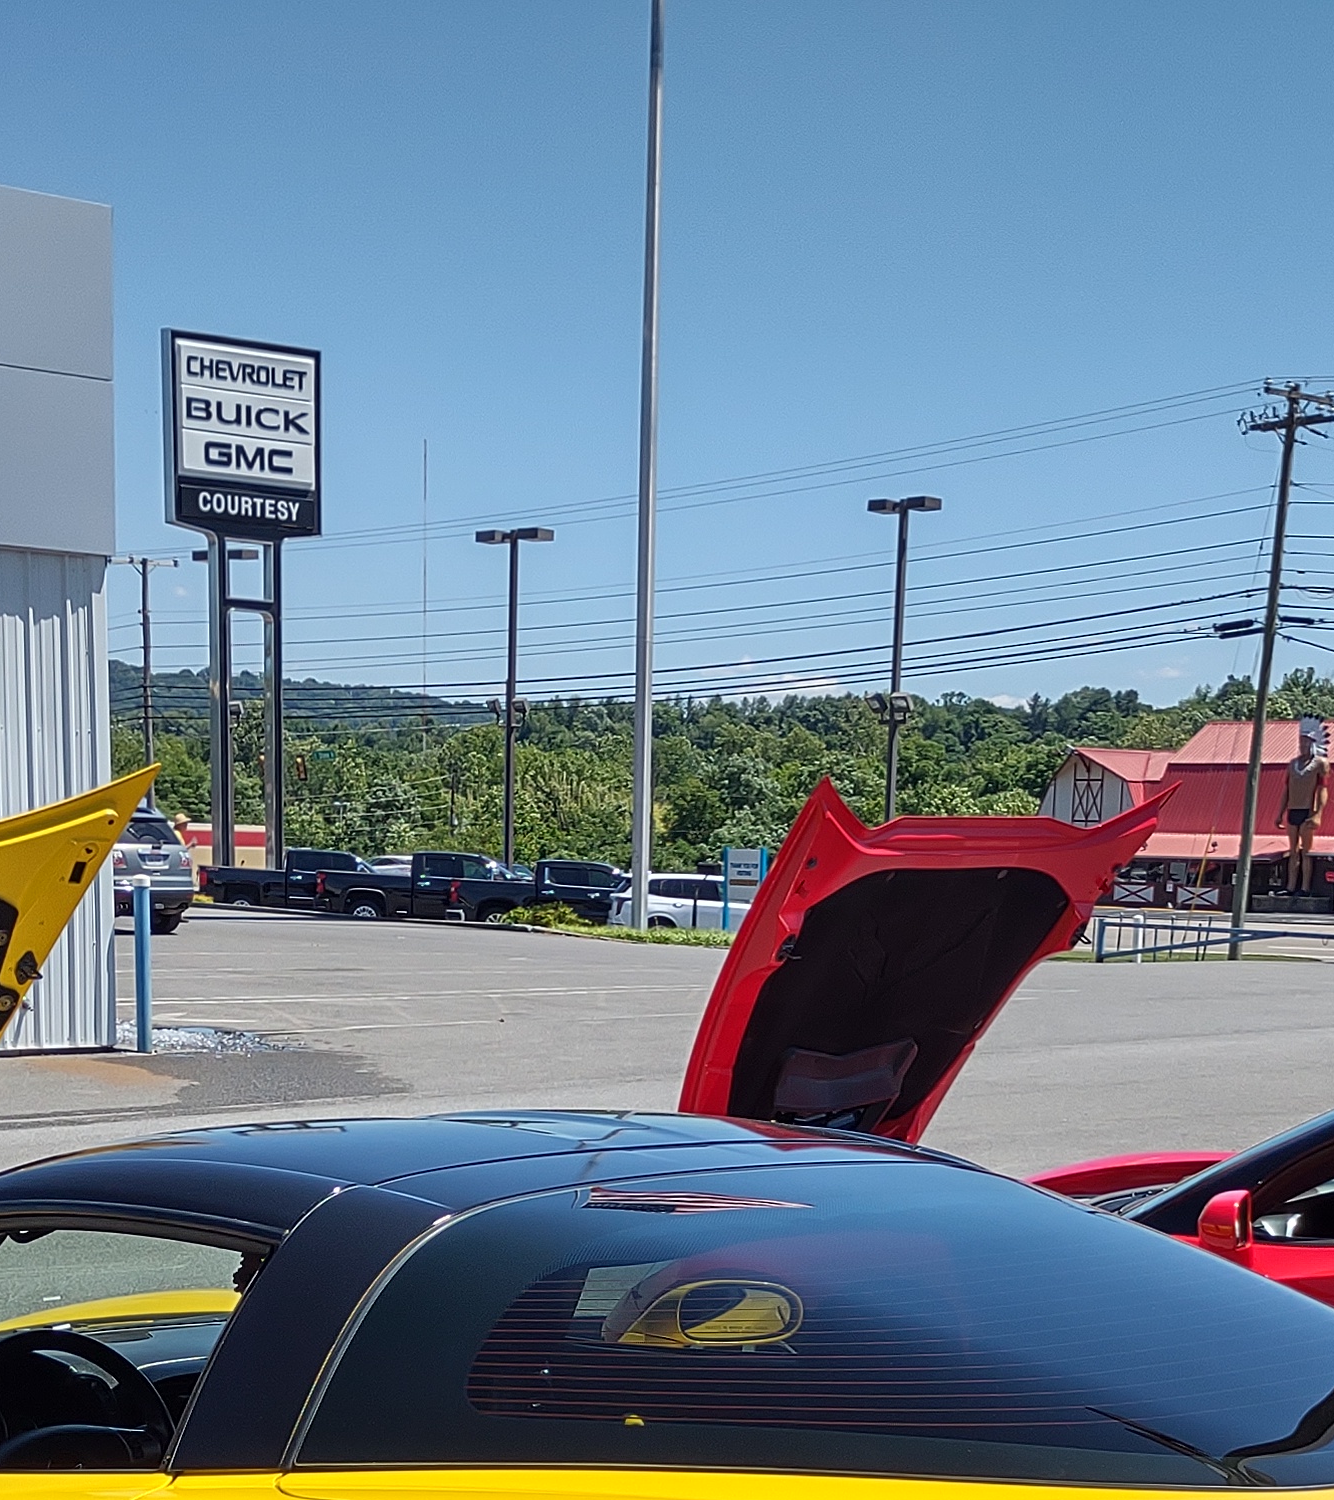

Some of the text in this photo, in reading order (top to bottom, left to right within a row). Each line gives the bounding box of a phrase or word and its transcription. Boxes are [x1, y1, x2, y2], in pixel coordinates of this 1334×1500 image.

[186, 355, 308, 391] CHEVROLET
[185, 396, 310, 435] BUICK
[204, 440, 294, 474] GMC
[198, 491, 300, 521] COURTESY
